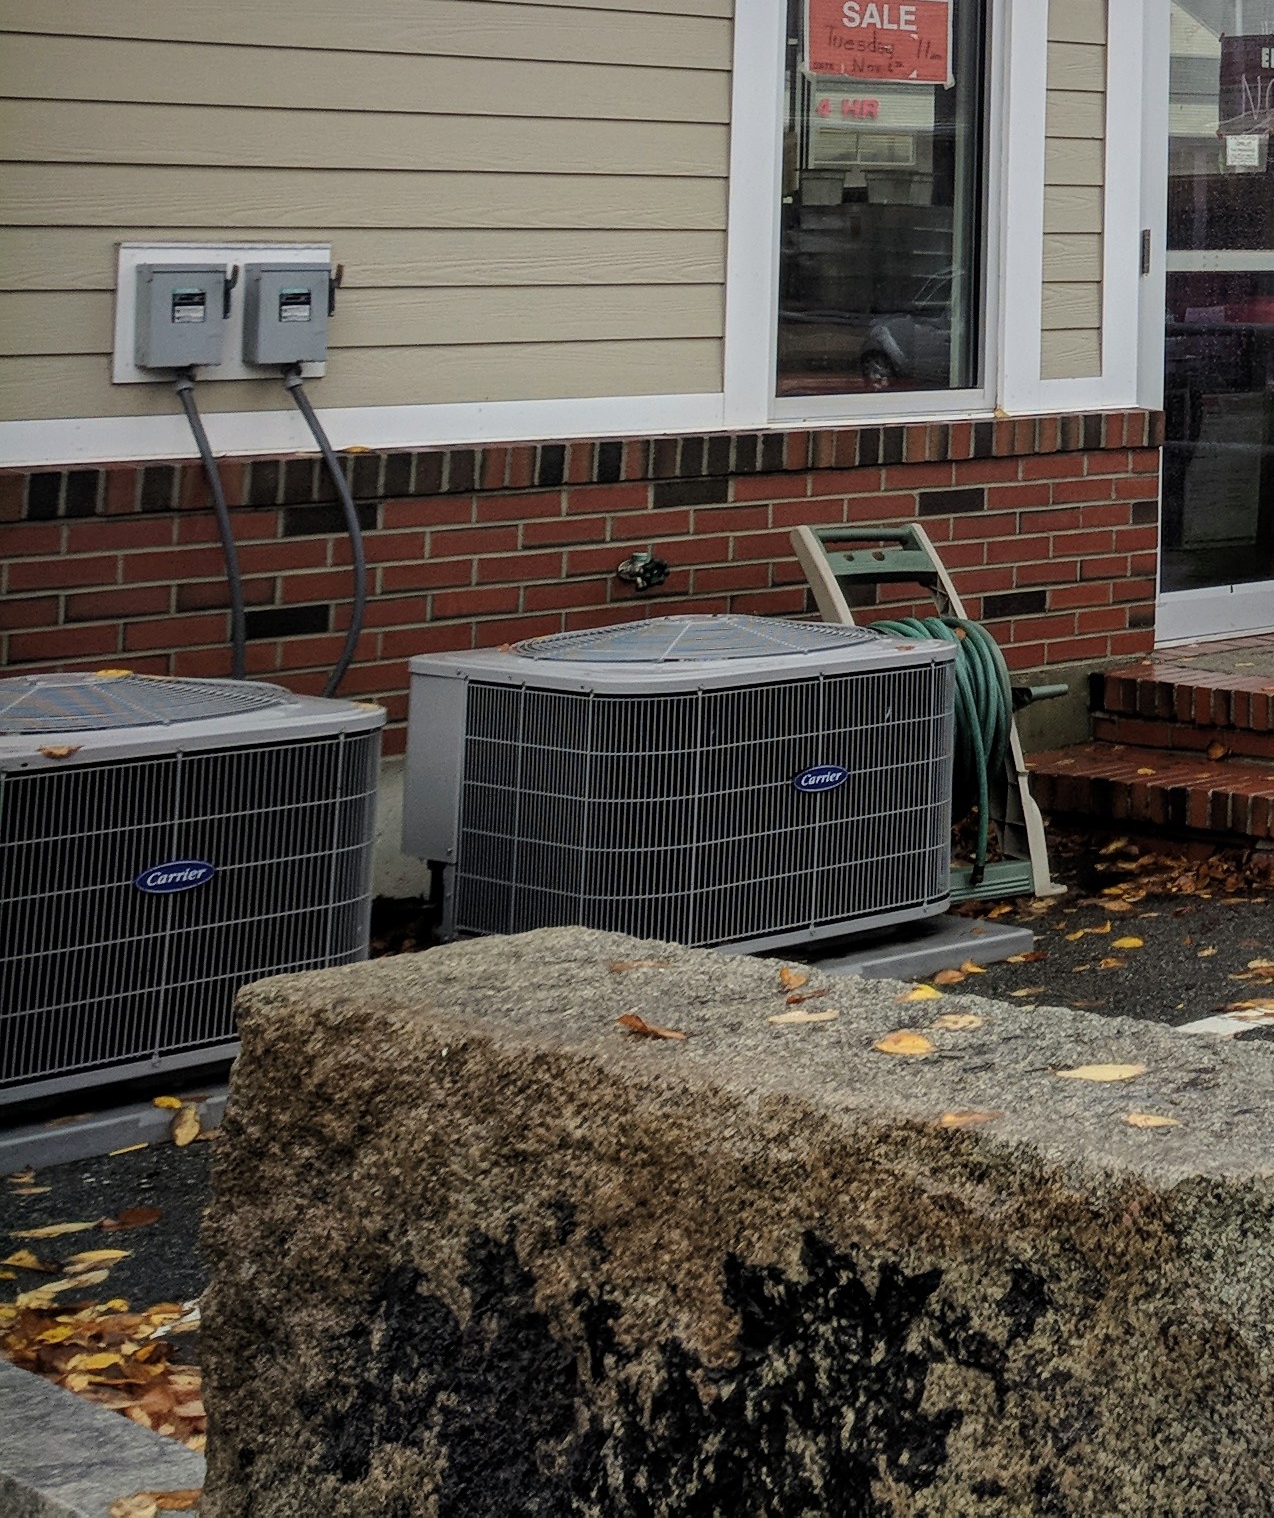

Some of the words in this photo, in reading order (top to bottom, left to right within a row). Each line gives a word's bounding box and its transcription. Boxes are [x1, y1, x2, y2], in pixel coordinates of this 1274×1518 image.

[842, 1, 918, 31] SALE
[801, 771, 843, 786] Carrier
[146, 868, 207, 887] Carrier
